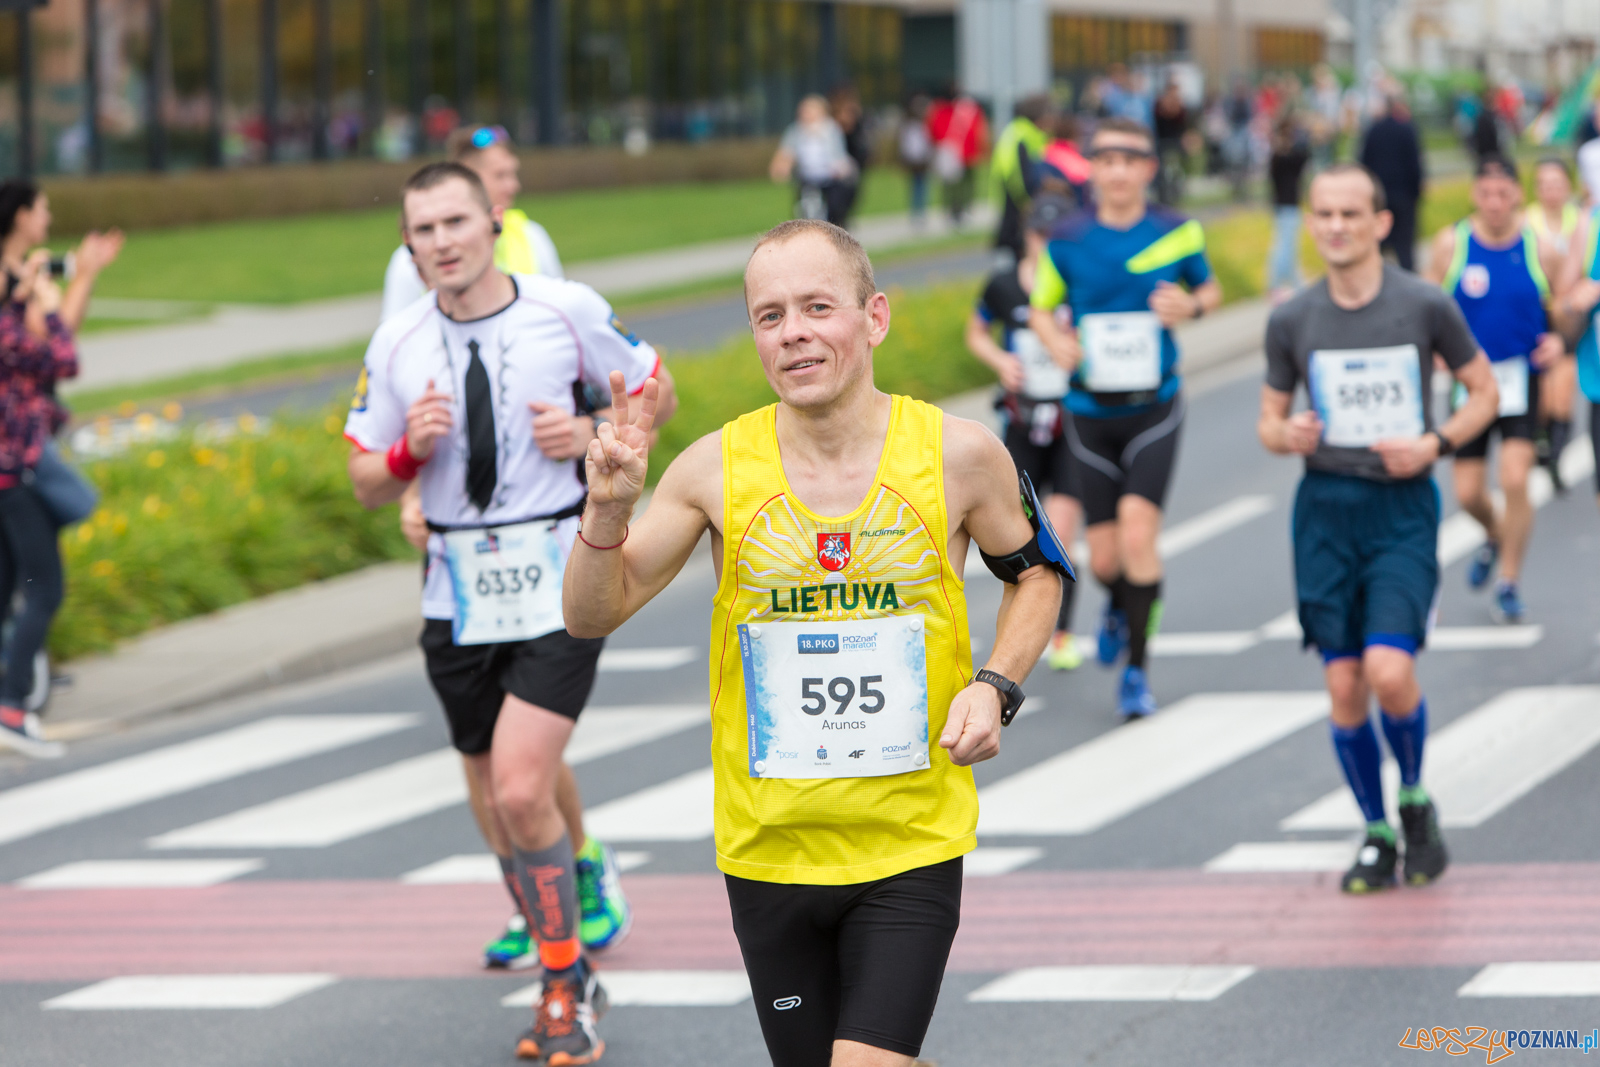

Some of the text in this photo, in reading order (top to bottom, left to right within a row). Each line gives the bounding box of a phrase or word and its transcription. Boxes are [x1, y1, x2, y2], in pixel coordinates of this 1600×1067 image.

[476, 565, 543, 596] 6339
[771, 583, 899, 613] LIETUVA
[801, 640, 836, 649] 18. PKO
[843, 641, 877, 649] maraton
[801, 674, 886, 716] 595
[821, 719, 866, 730] Arunas
